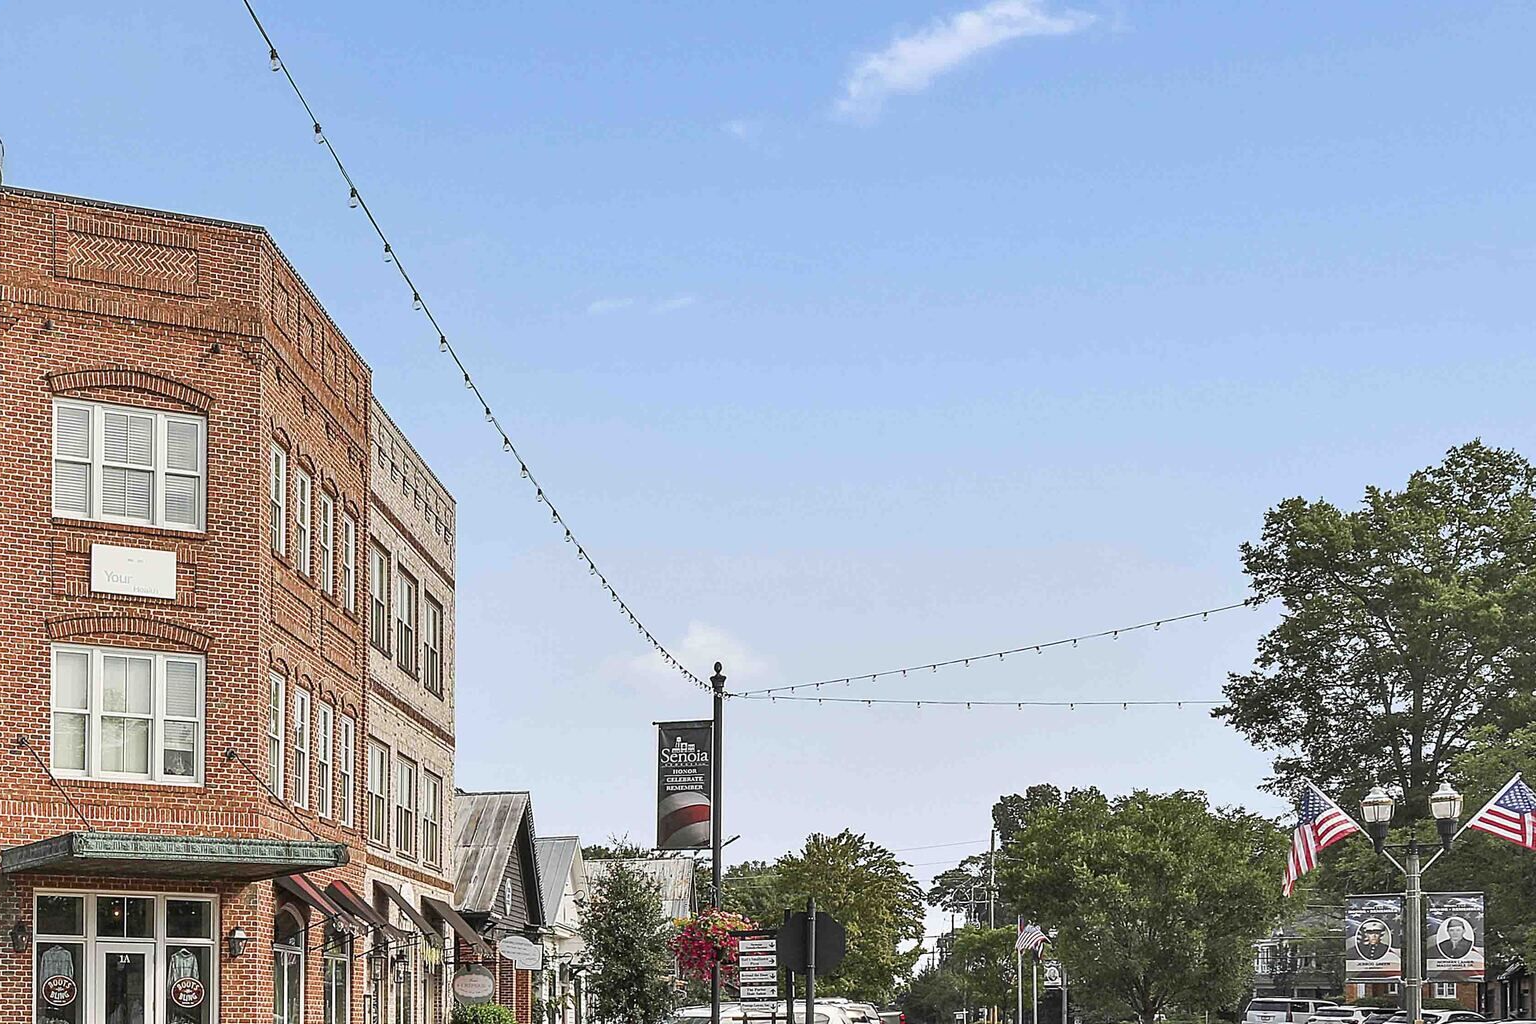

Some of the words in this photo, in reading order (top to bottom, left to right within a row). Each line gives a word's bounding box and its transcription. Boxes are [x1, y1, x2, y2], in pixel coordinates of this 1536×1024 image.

[104, 570, 134, 584] Your
[661, 748, 709, 763] Senoia
[119, 954, 131, 964] 1A
[47, 979, 72, 989] BOOTS
[177, 981, 200, 991] BOOTS
[50, 990, 70, 1000] BLING
